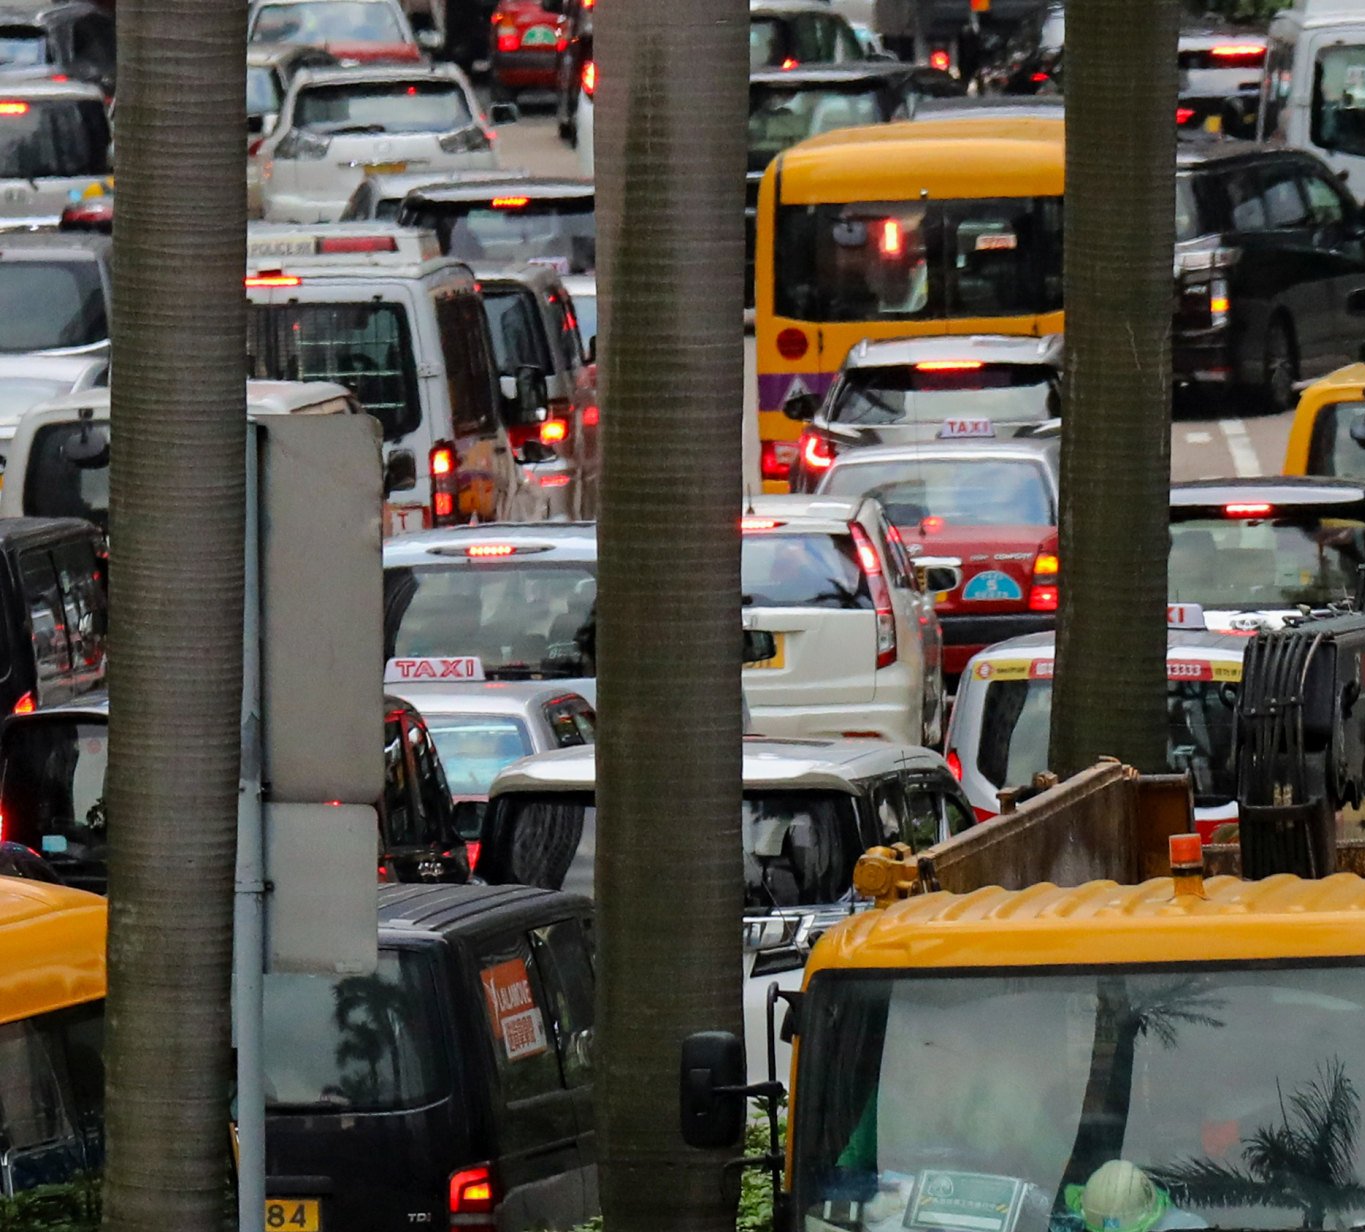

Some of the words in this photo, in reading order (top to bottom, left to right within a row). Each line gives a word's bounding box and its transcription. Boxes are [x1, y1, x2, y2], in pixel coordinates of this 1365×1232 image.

[948, 421, 989, 433] TAXI
[395, 660, 475, 678] TAXI
[267, 1204, 307, 1228] 84
